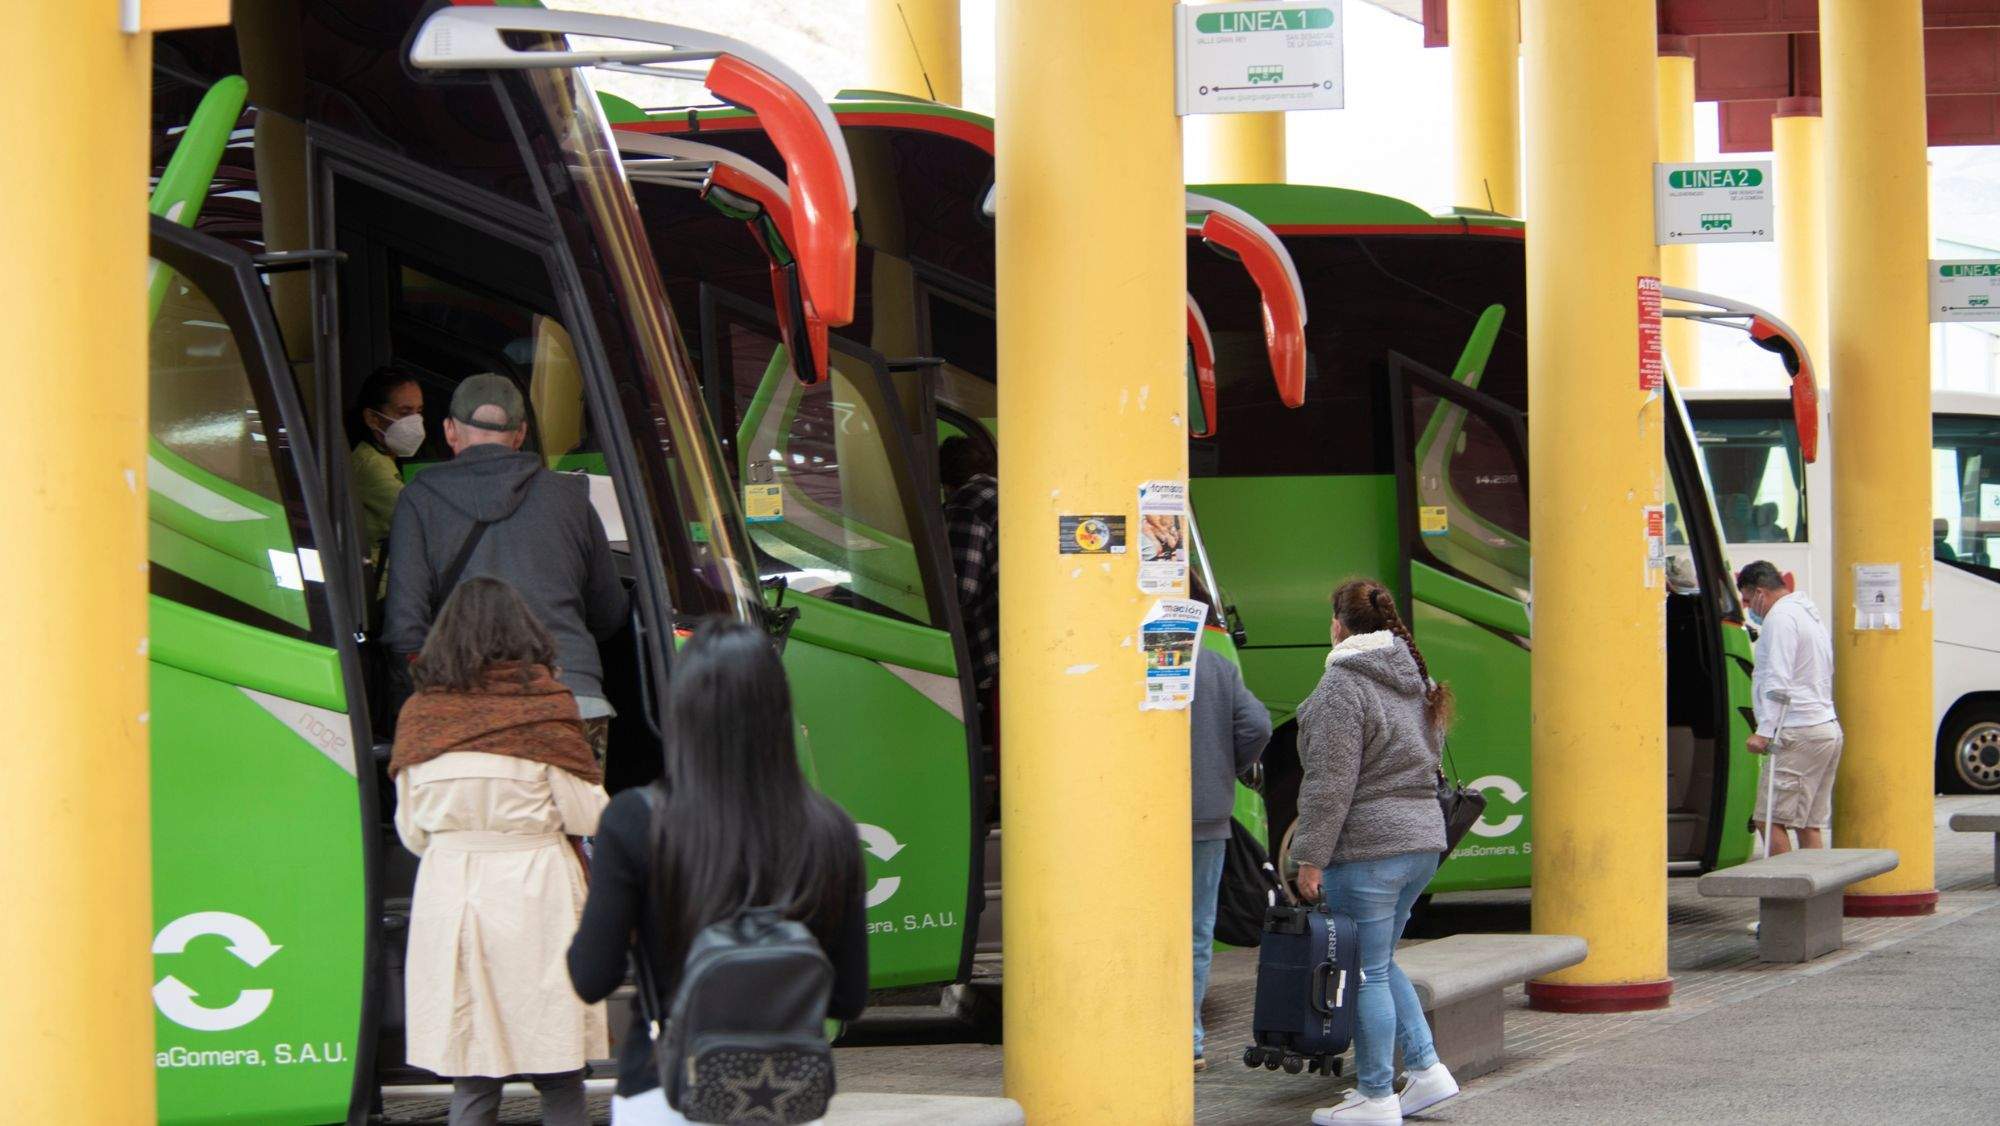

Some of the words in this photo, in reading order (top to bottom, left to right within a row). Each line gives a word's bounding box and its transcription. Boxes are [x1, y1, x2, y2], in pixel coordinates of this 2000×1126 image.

[1220, 11, 1287, 32] LINEA
[1297, 11, 1308, 29] 1
[1682, 170, 1735, 187] LINEA
[1738, 169, 1749, 186] 2
[1952, 265, 1991, 276] LINEA
[903, 911, 957, 931] S.A.U.
[274, 1042, 348, 1064] S.A.U.
